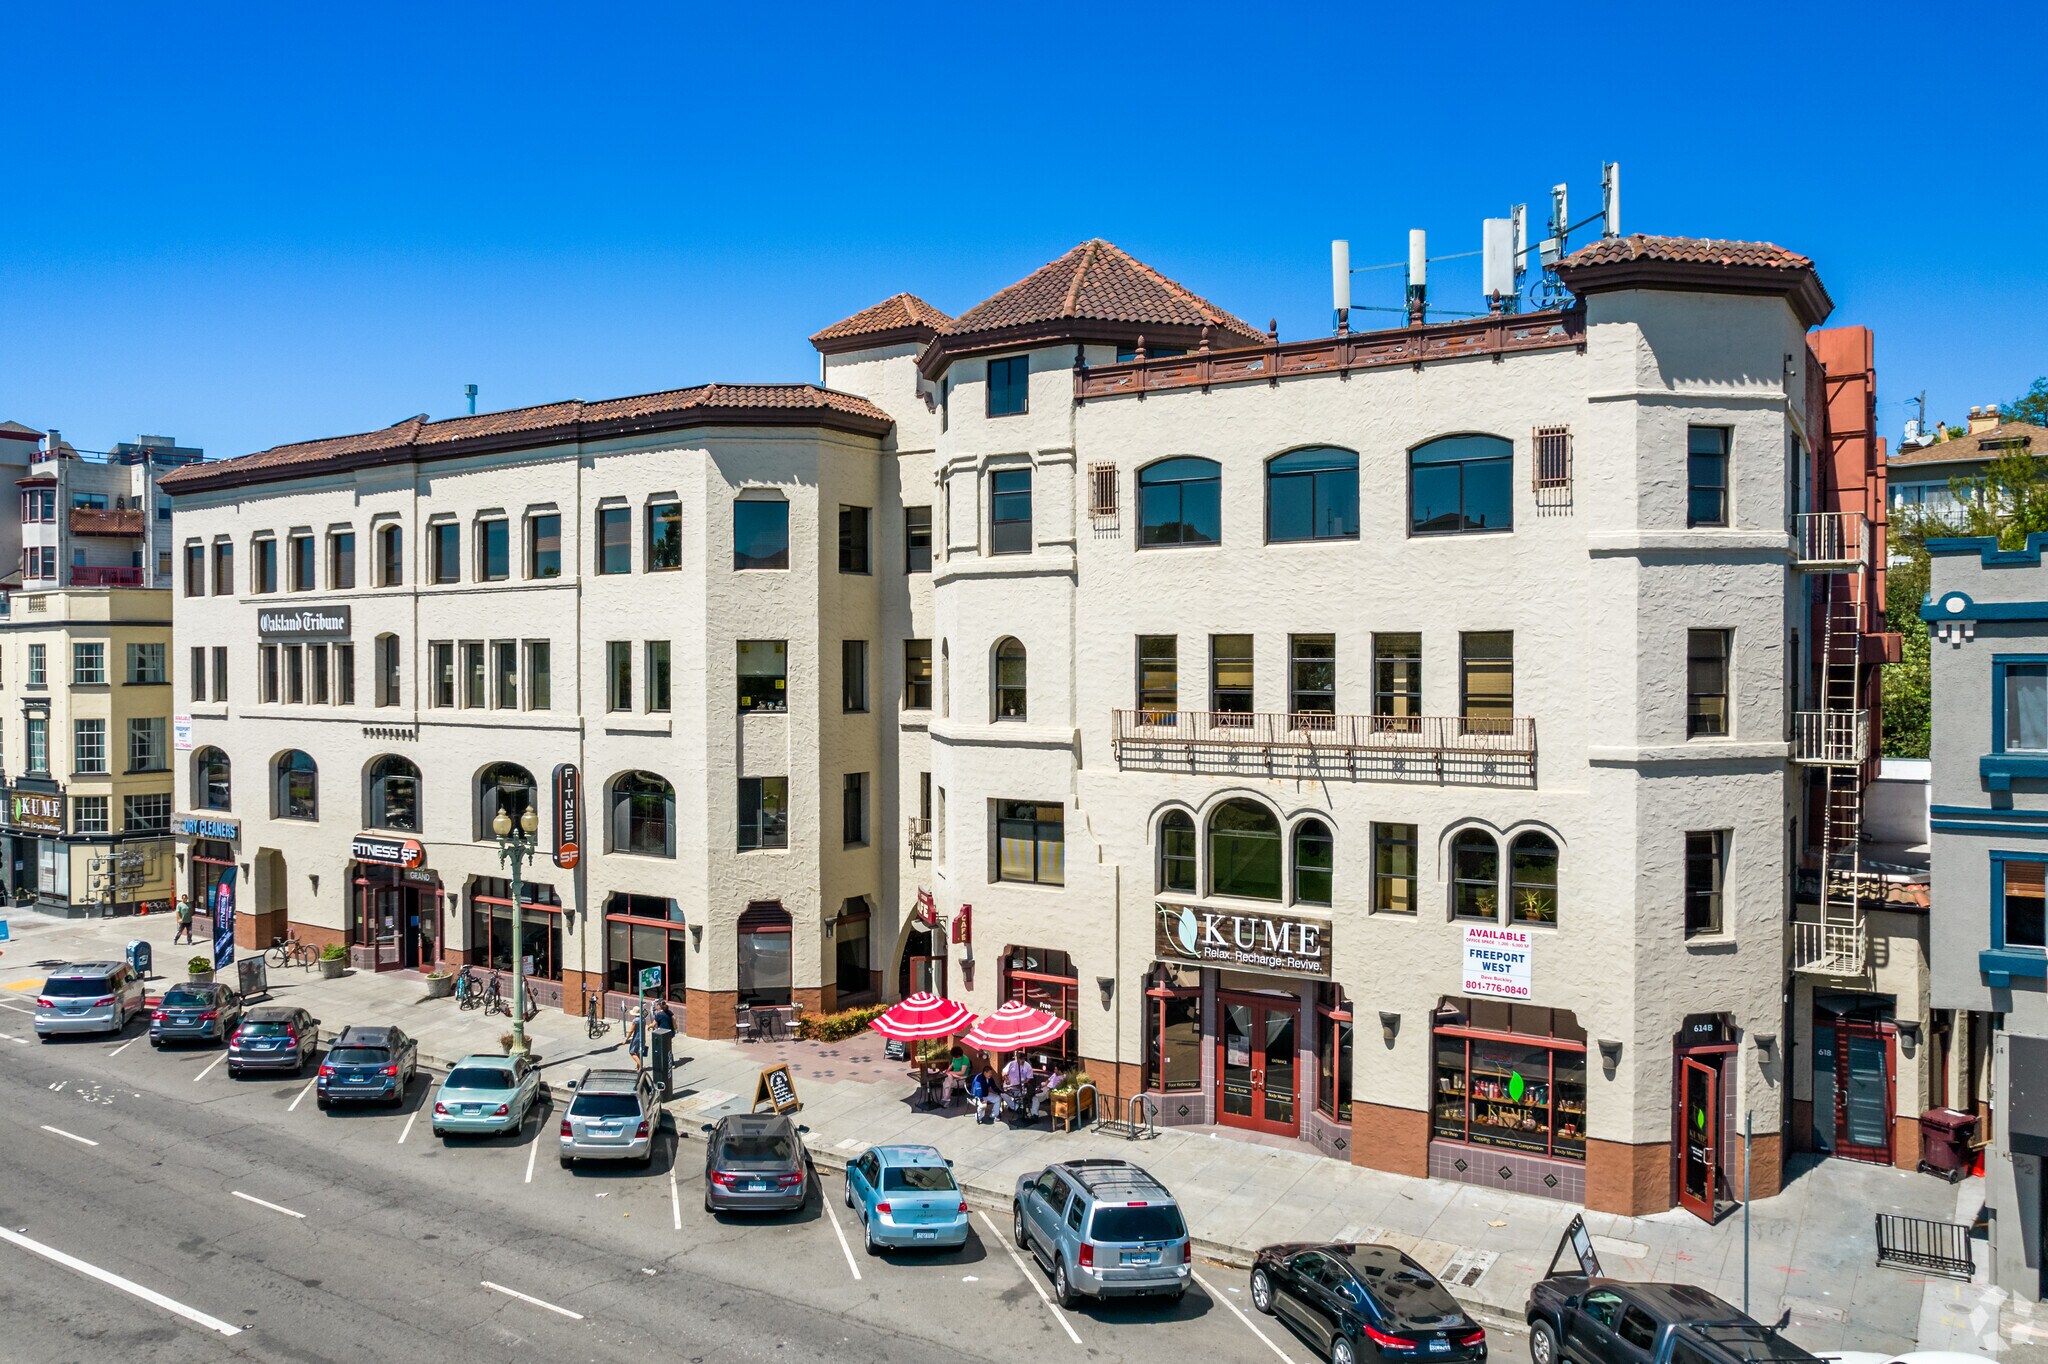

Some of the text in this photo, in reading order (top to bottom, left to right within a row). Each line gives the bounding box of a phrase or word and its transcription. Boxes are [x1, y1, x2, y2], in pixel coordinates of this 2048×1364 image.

[260, 611, 345, 632] Oakland Tribune
[21, 796, 60, 818] KUME
[564, 768, 574, 841] FITNESS
[184, 819, 198, 834] DRY
[199, 820, 236, 839] CLEANERS
[351, 842, 418, 861] FITNESS SF
[560, 850, 579, 863] SF
[410, 871, 431, 881] GRAND
[1202, 913, 1321, 957] KUME
[1469, 928, 1526, 942] AVAILABLE
[1204, 947, 1323, 971] Relax. Recharge. Revive.
[1469, 948, 1525, 963] FREEPORT
[1482, 961, 1512, 973] WEST
[1466, 980, 1528, 995] 801-776-0840
